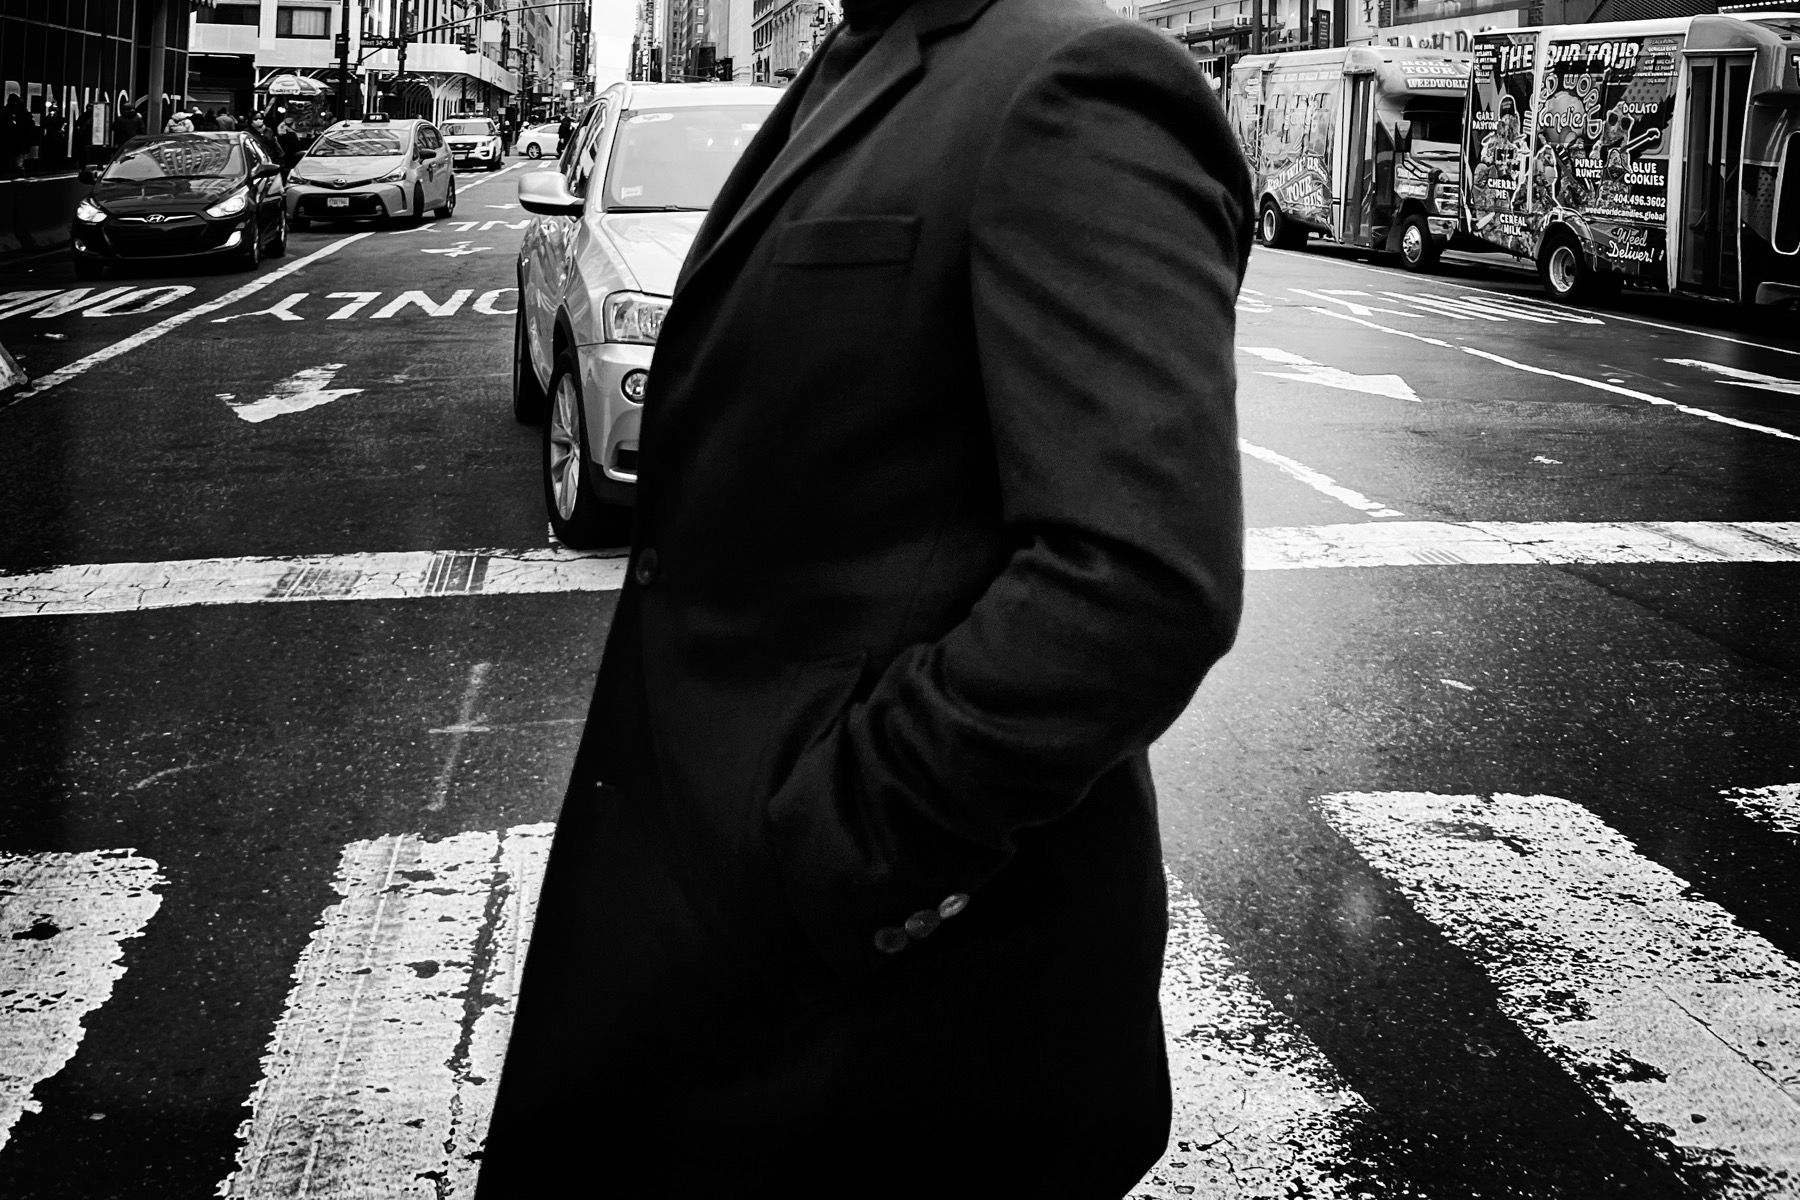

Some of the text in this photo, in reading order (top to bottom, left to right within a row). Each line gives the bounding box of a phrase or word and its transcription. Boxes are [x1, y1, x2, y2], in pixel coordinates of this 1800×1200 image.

[1499, 44, 1535, 73] THE
[1406, 79, 1469, 89] WEEDWORL
[1622, 103, 1659, 115] DOLATO
[1538, 105, 1587, 133] Candies
[1575, 159, 1604, 169] PURPLE
[1632, 161, 1657, 174] BLUE
[1575, 168, 1601, 179] RUNTZ
[1623, 173, 1665, 186] COOKIES
[1285, 176, 1312, 202] TOUR
[1487, 178, 1517, 191] CHERRY
[1495, 189, 1508, 199] PIE
[1613, 193, 1666, 208] 404.496.3602
[1500, 213, 1527, 227] CEREAL
[1584, 206, 1666, 221] weedworldcandies.global
[1503, 225, 1521, 236] MILK
[1606, 240, 1655, 263] Deliver!
